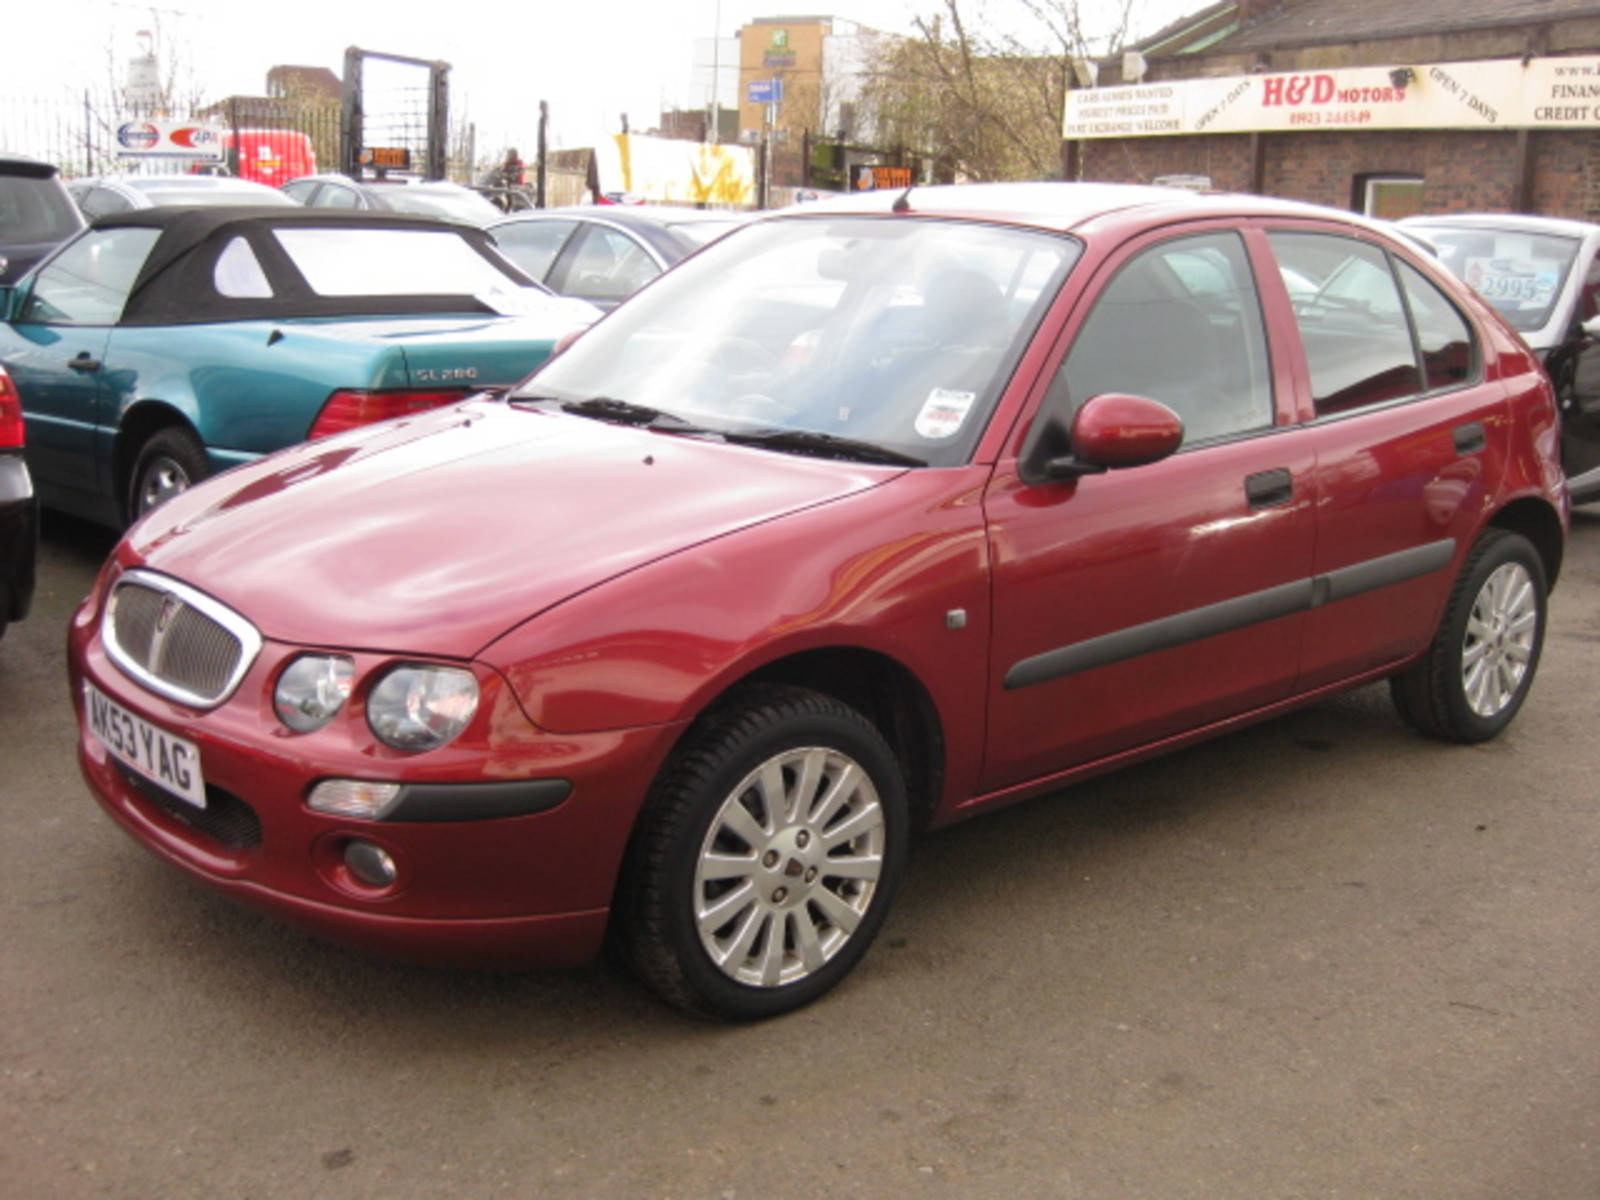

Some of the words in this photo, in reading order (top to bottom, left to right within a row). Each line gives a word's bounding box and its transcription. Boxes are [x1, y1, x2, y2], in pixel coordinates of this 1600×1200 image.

[1195, 109, 1217, 131] OPEN
[1227, 79, 1251, 103] DAYS
[1262, 74, 1336, 107] H&D
[1337, 87, 1406, 103] MOTORS
[1429, 67, 1459, 94] OPEN
[1467, 96, 1498, 124] DAYS
[1534, 106, 1590, 121] CREDIT
[139, 724, 191, 791] YAG
